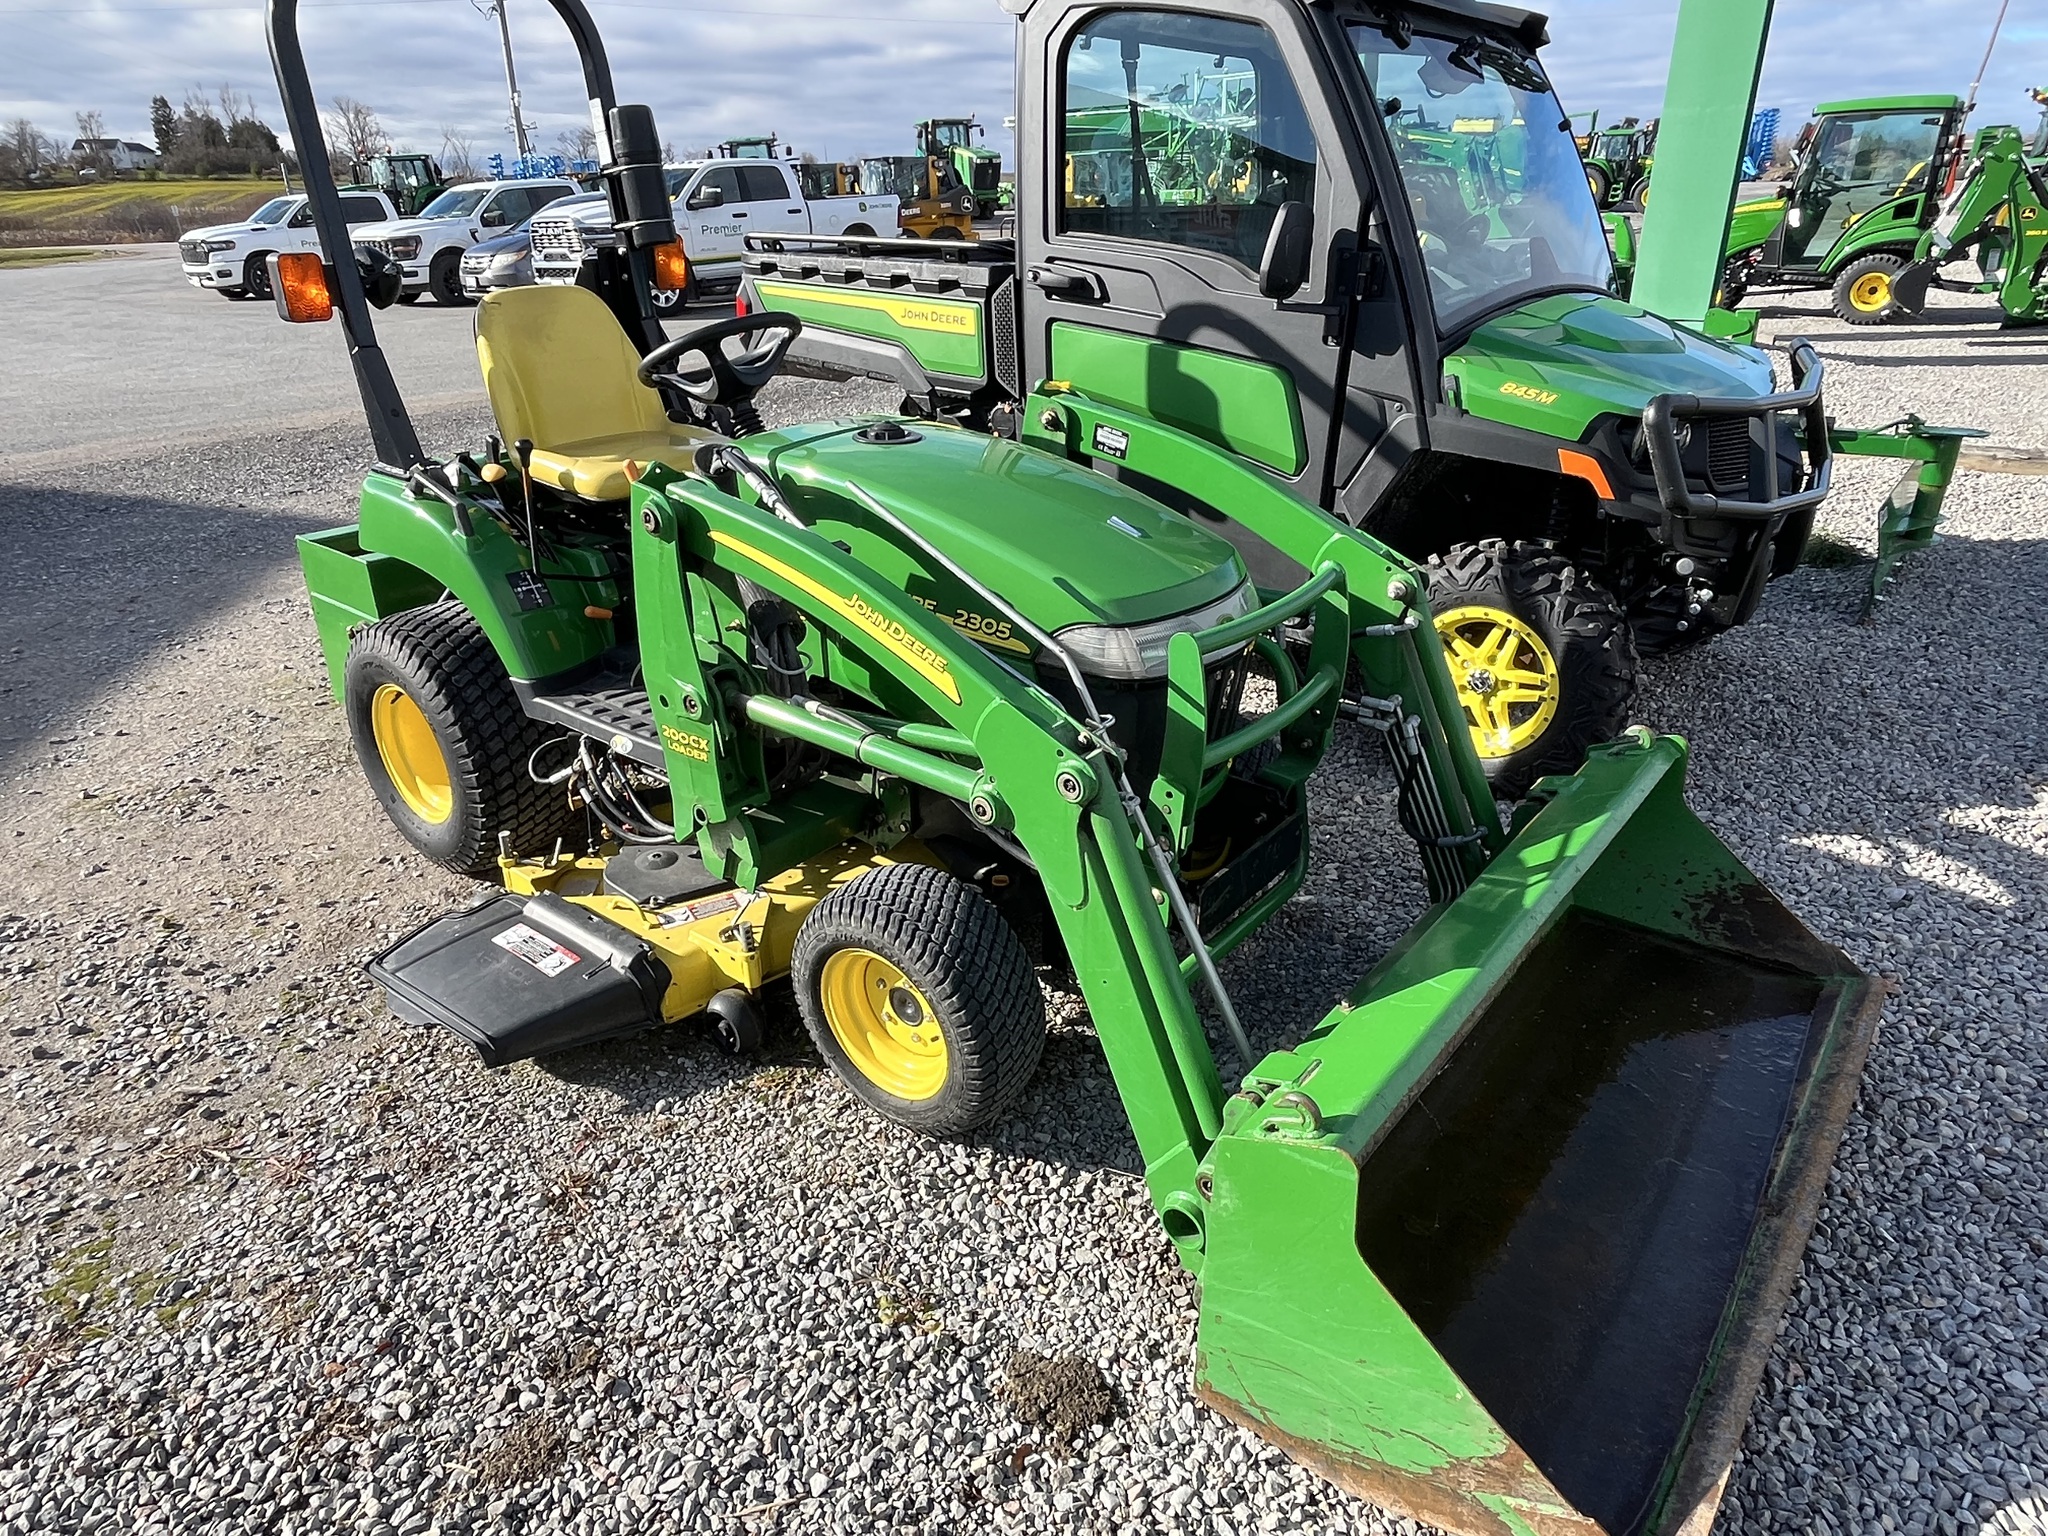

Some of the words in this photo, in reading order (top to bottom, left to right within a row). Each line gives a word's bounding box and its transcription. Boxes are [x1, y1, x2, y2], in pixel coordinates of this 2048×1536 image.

[701, 222, 742, 235] Premier
[901, 308, 929, 321] JOHN
[930, 311, 967, 326] DEERE
[1499, 382, 1559, 405] 845M
[843, 593, 890, 633] JOHN
[887, 620, 949, 673] DEERE
[953, 609, 1012, 639] 2305
[661, 724, 710, 752] 200CX
[667, 739, 709, 763] LOADER
